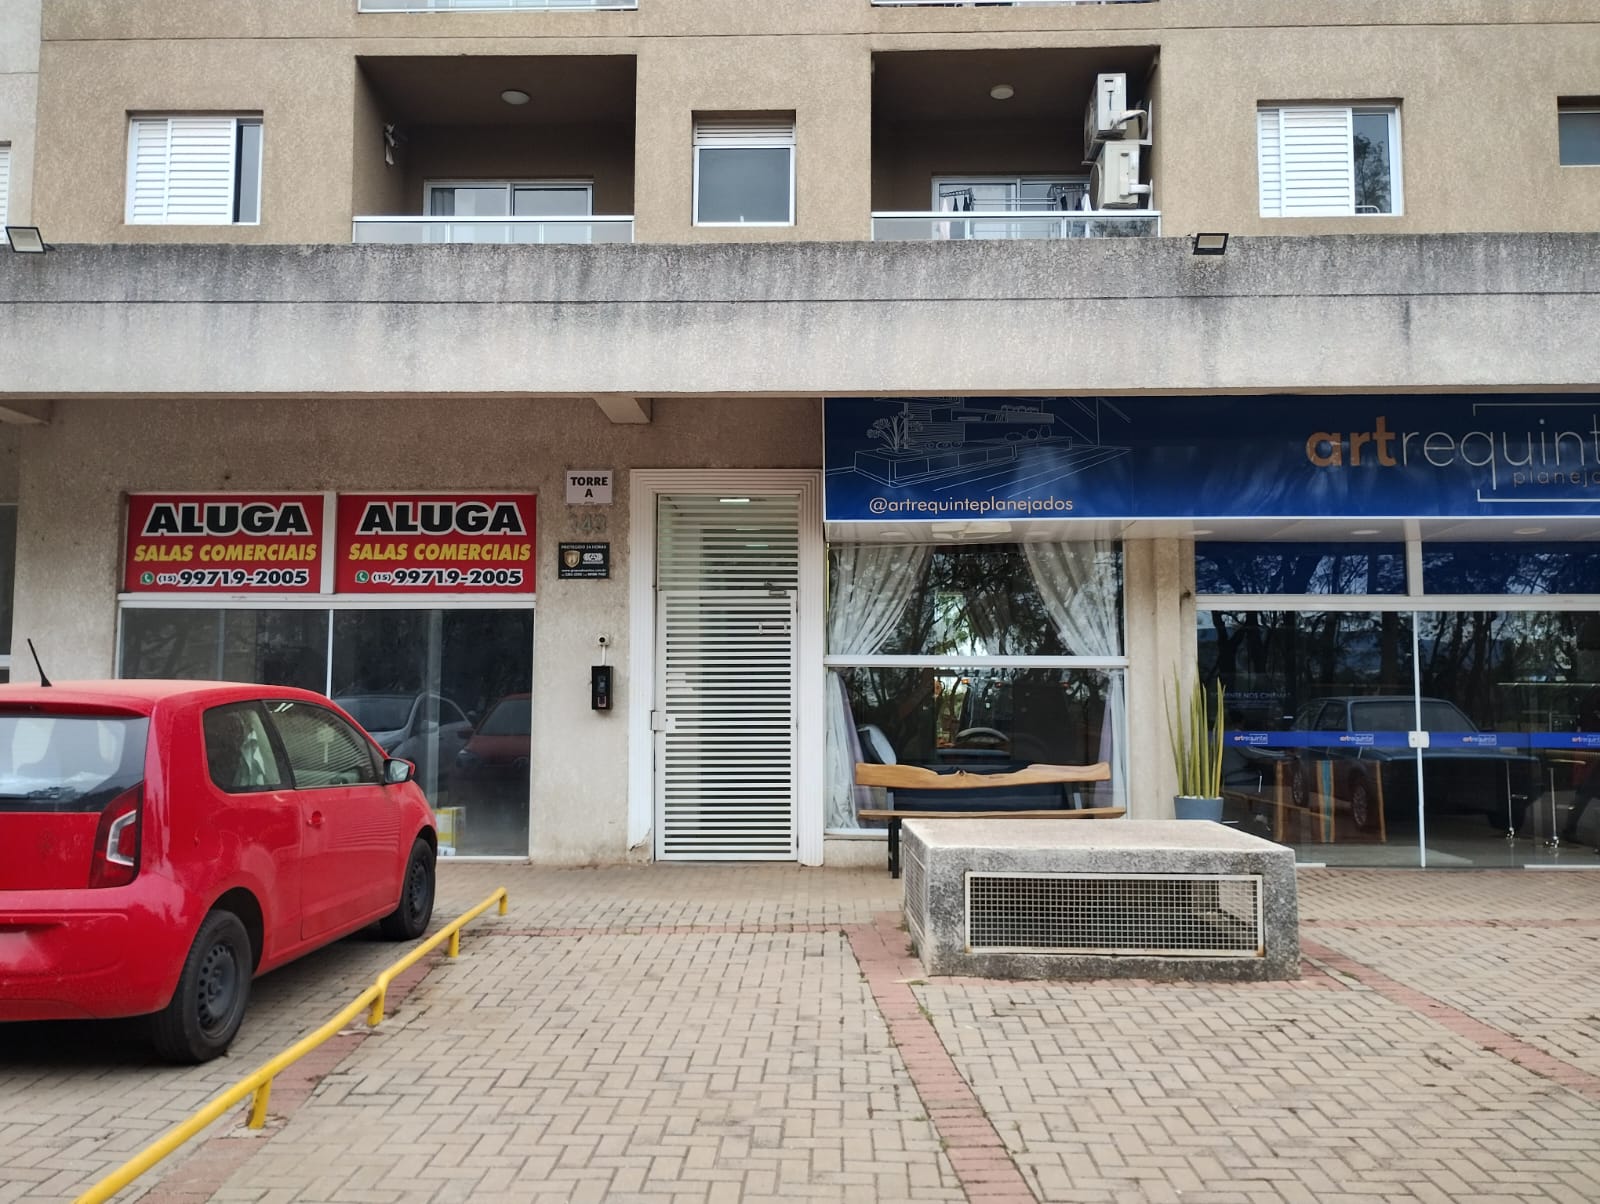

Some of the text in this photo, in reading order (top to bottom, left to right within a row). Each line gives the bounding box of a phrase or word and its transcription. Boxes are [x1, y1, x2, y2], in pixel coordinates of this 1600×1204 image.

[570, 476, 609, 486] TORRE
[584, 488, 594, 498] A
[869, 496, 1074, 515] @artrequinteplanejados
[142, 502, 312, 536] ALUGA
[355, 502, 527, 536] ALUGA
[134, 543, 318, 562] SALAS COMERCIAIS
[348, 542, 532, 561] SALAS COMERCIAIS
[179, 568, 310, 586] 99719-2005
[393, 567, 524, 586] 99719-2005
